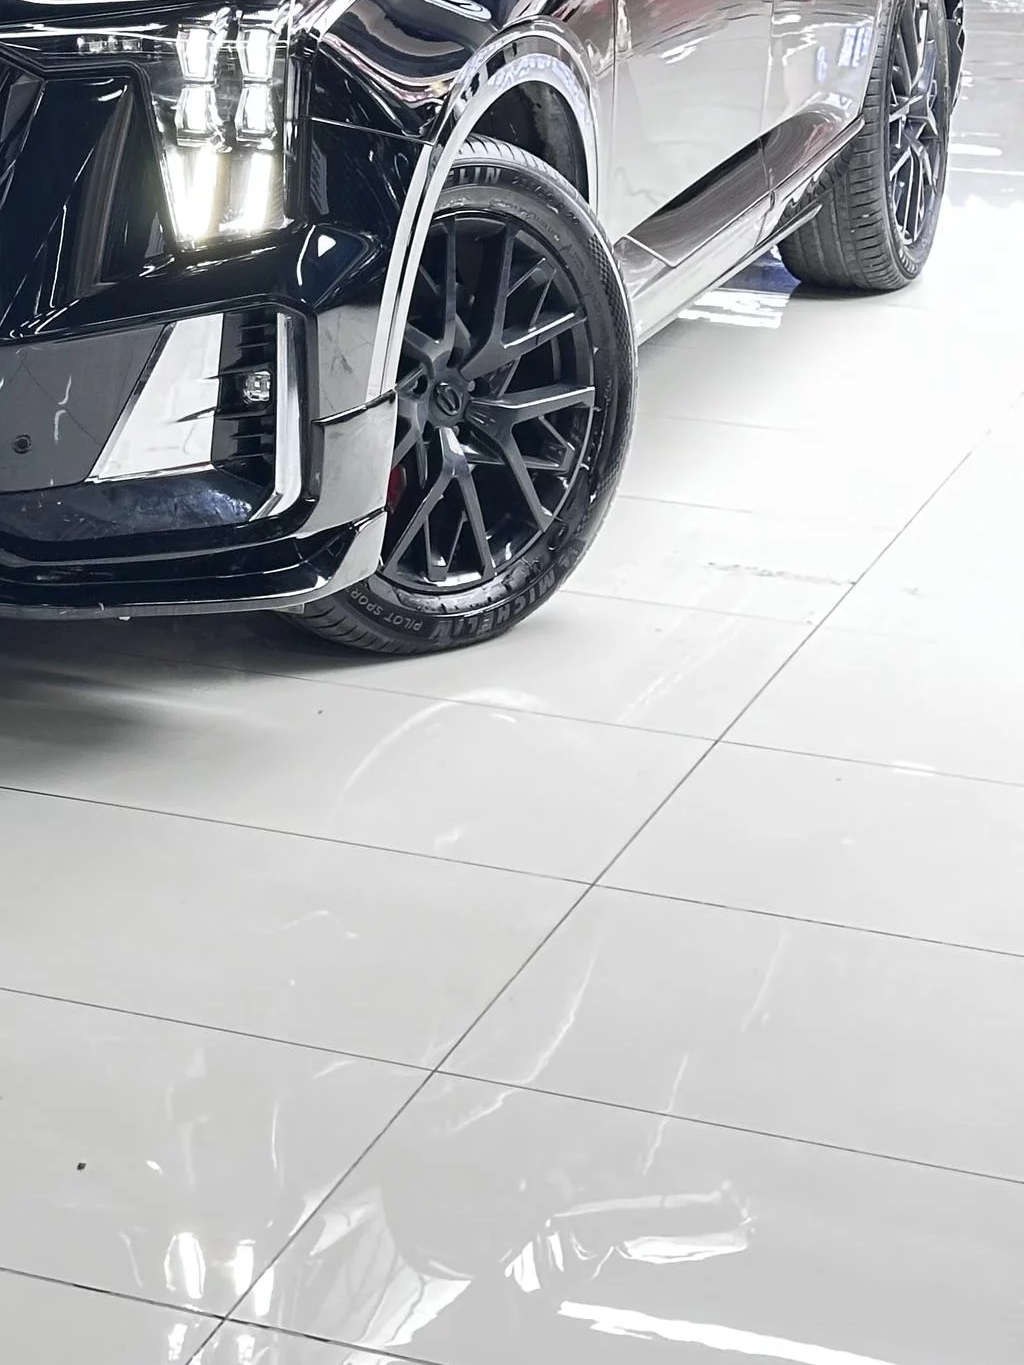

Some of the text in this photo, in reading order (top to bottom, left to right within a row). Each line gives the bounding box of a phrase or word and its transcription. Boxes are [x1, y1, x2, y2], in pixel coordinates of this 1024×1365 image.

[345, 586, 424, 632] PILOT SPOR
[428, 567, 556, 642] MICHELIN
